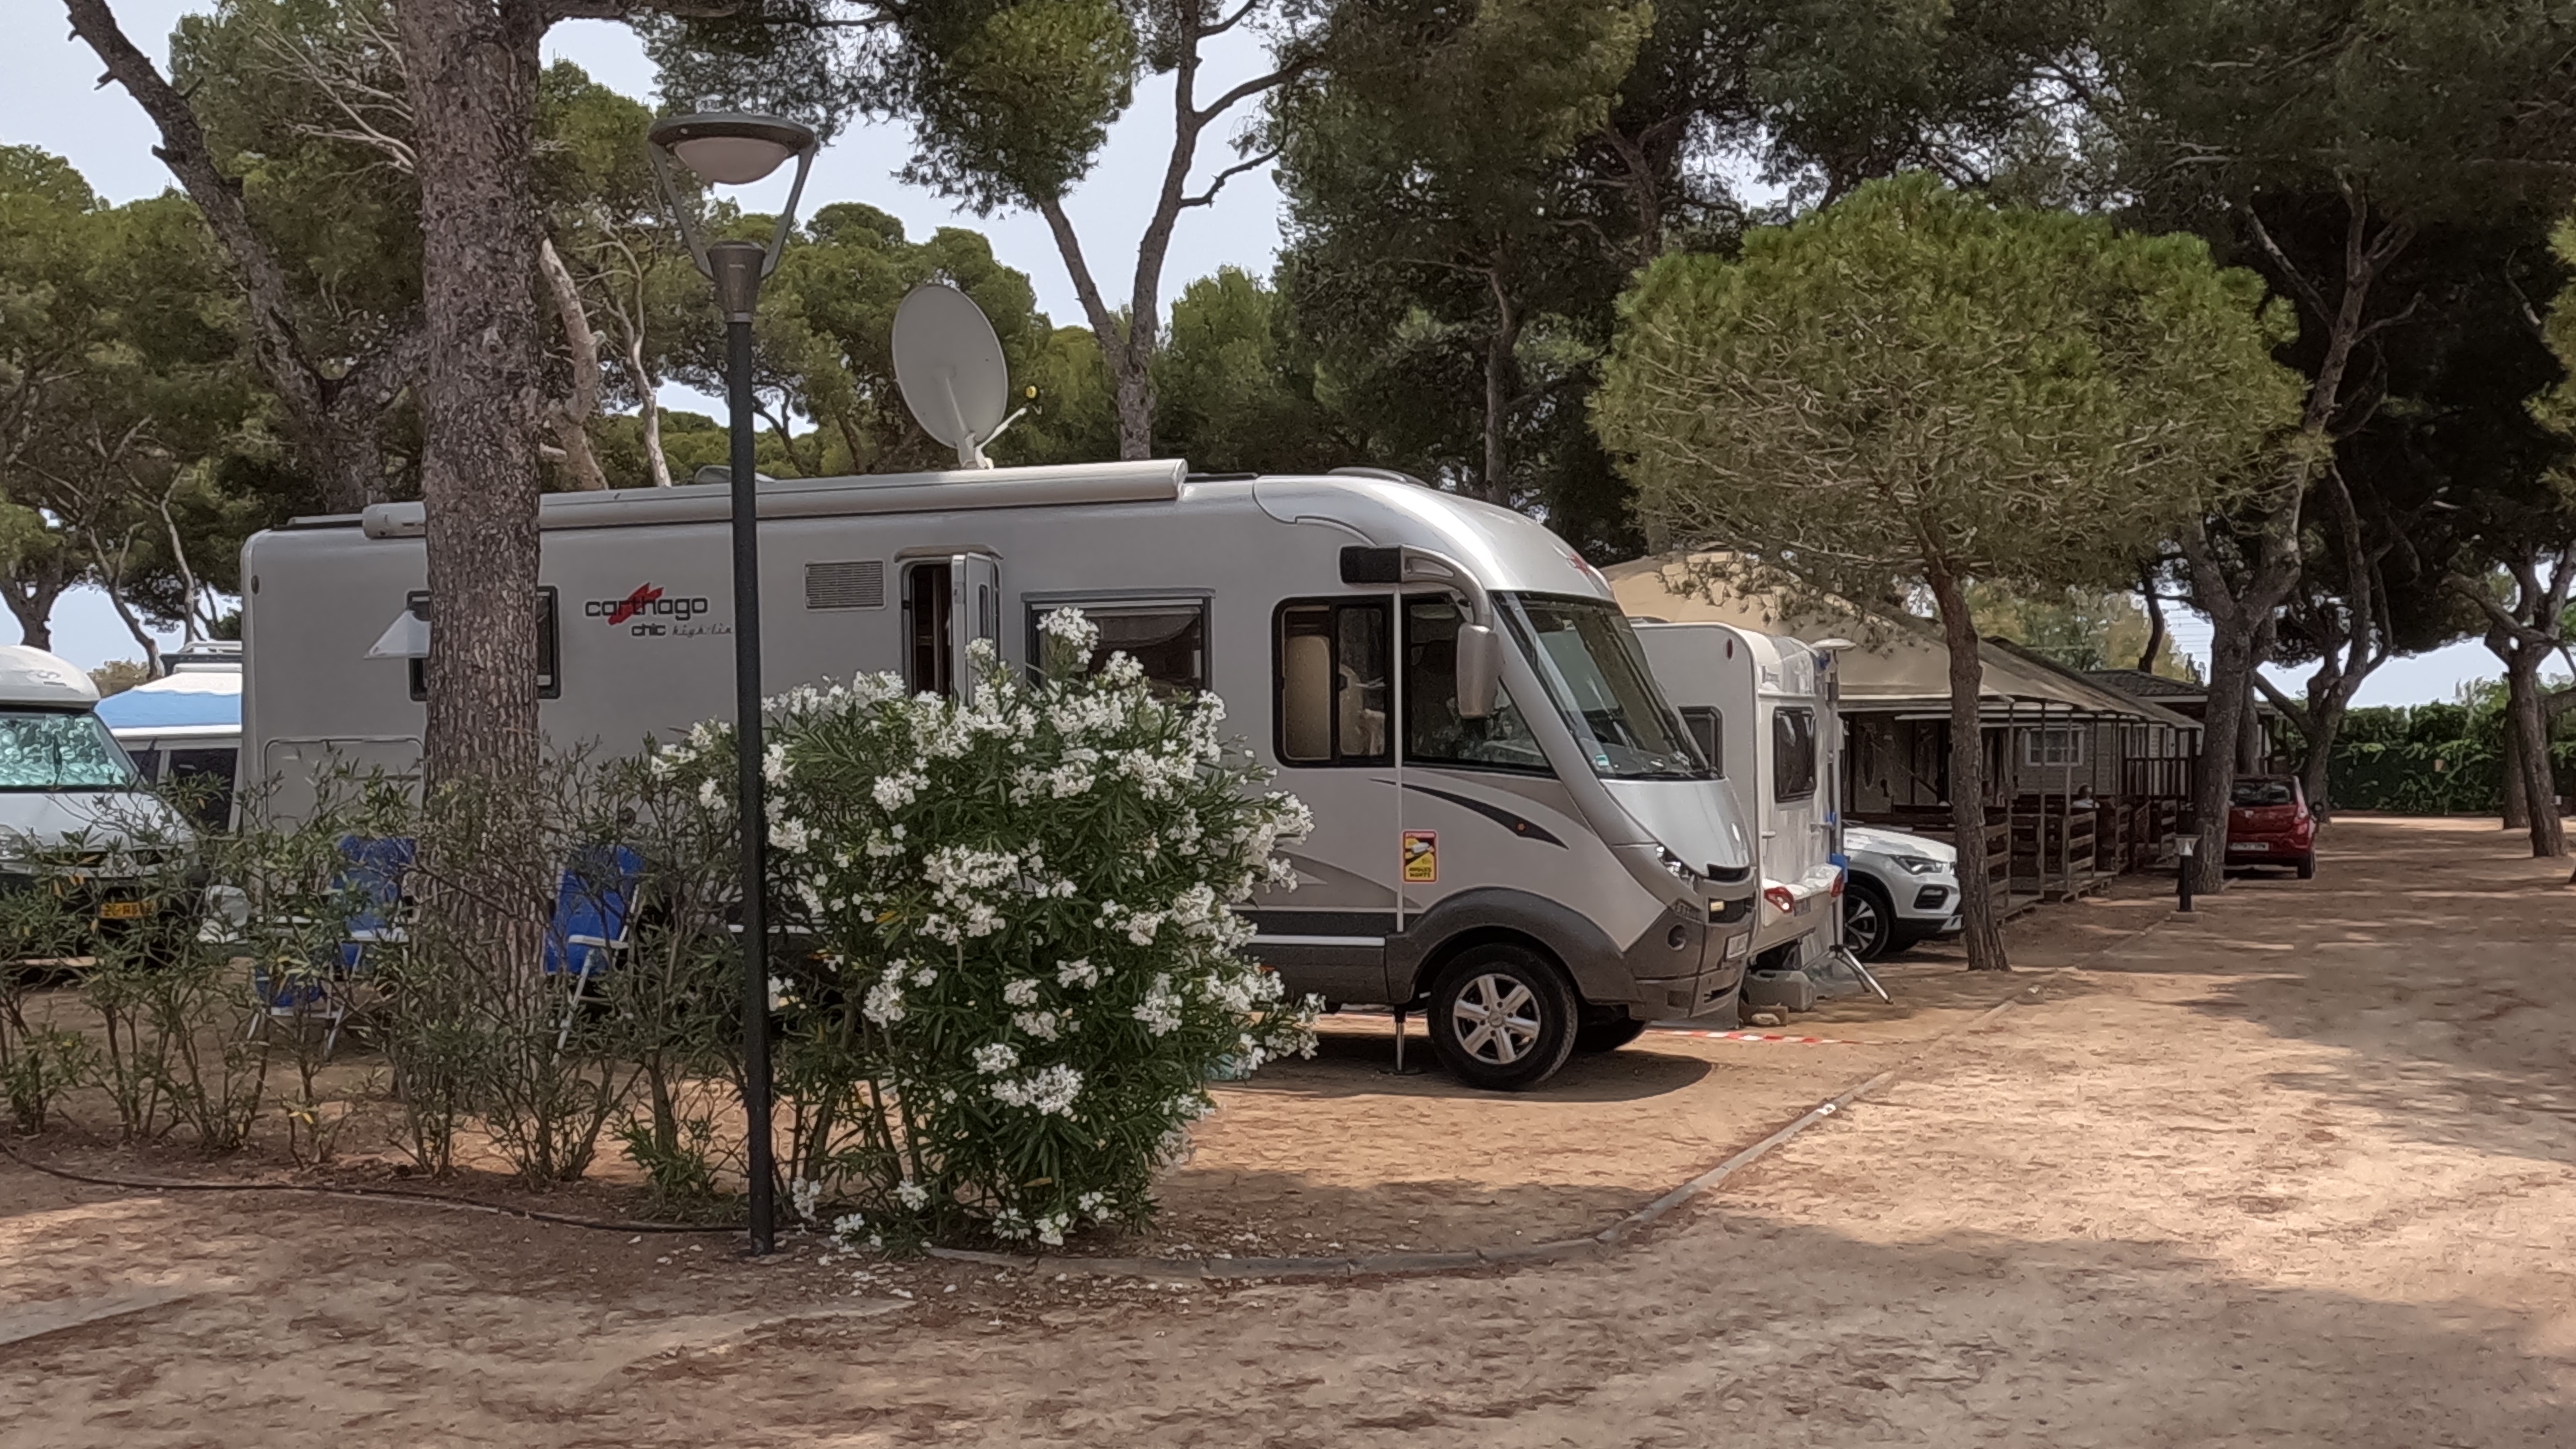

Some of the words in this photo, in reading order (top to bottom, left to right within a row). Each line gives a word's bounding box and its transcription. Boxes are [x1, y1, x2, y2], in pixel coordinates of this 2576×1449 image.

[585, 597, 708, 621] carthago
[632, 623, 666, 637] chic
[672, 623, 732, 638] high-lin
